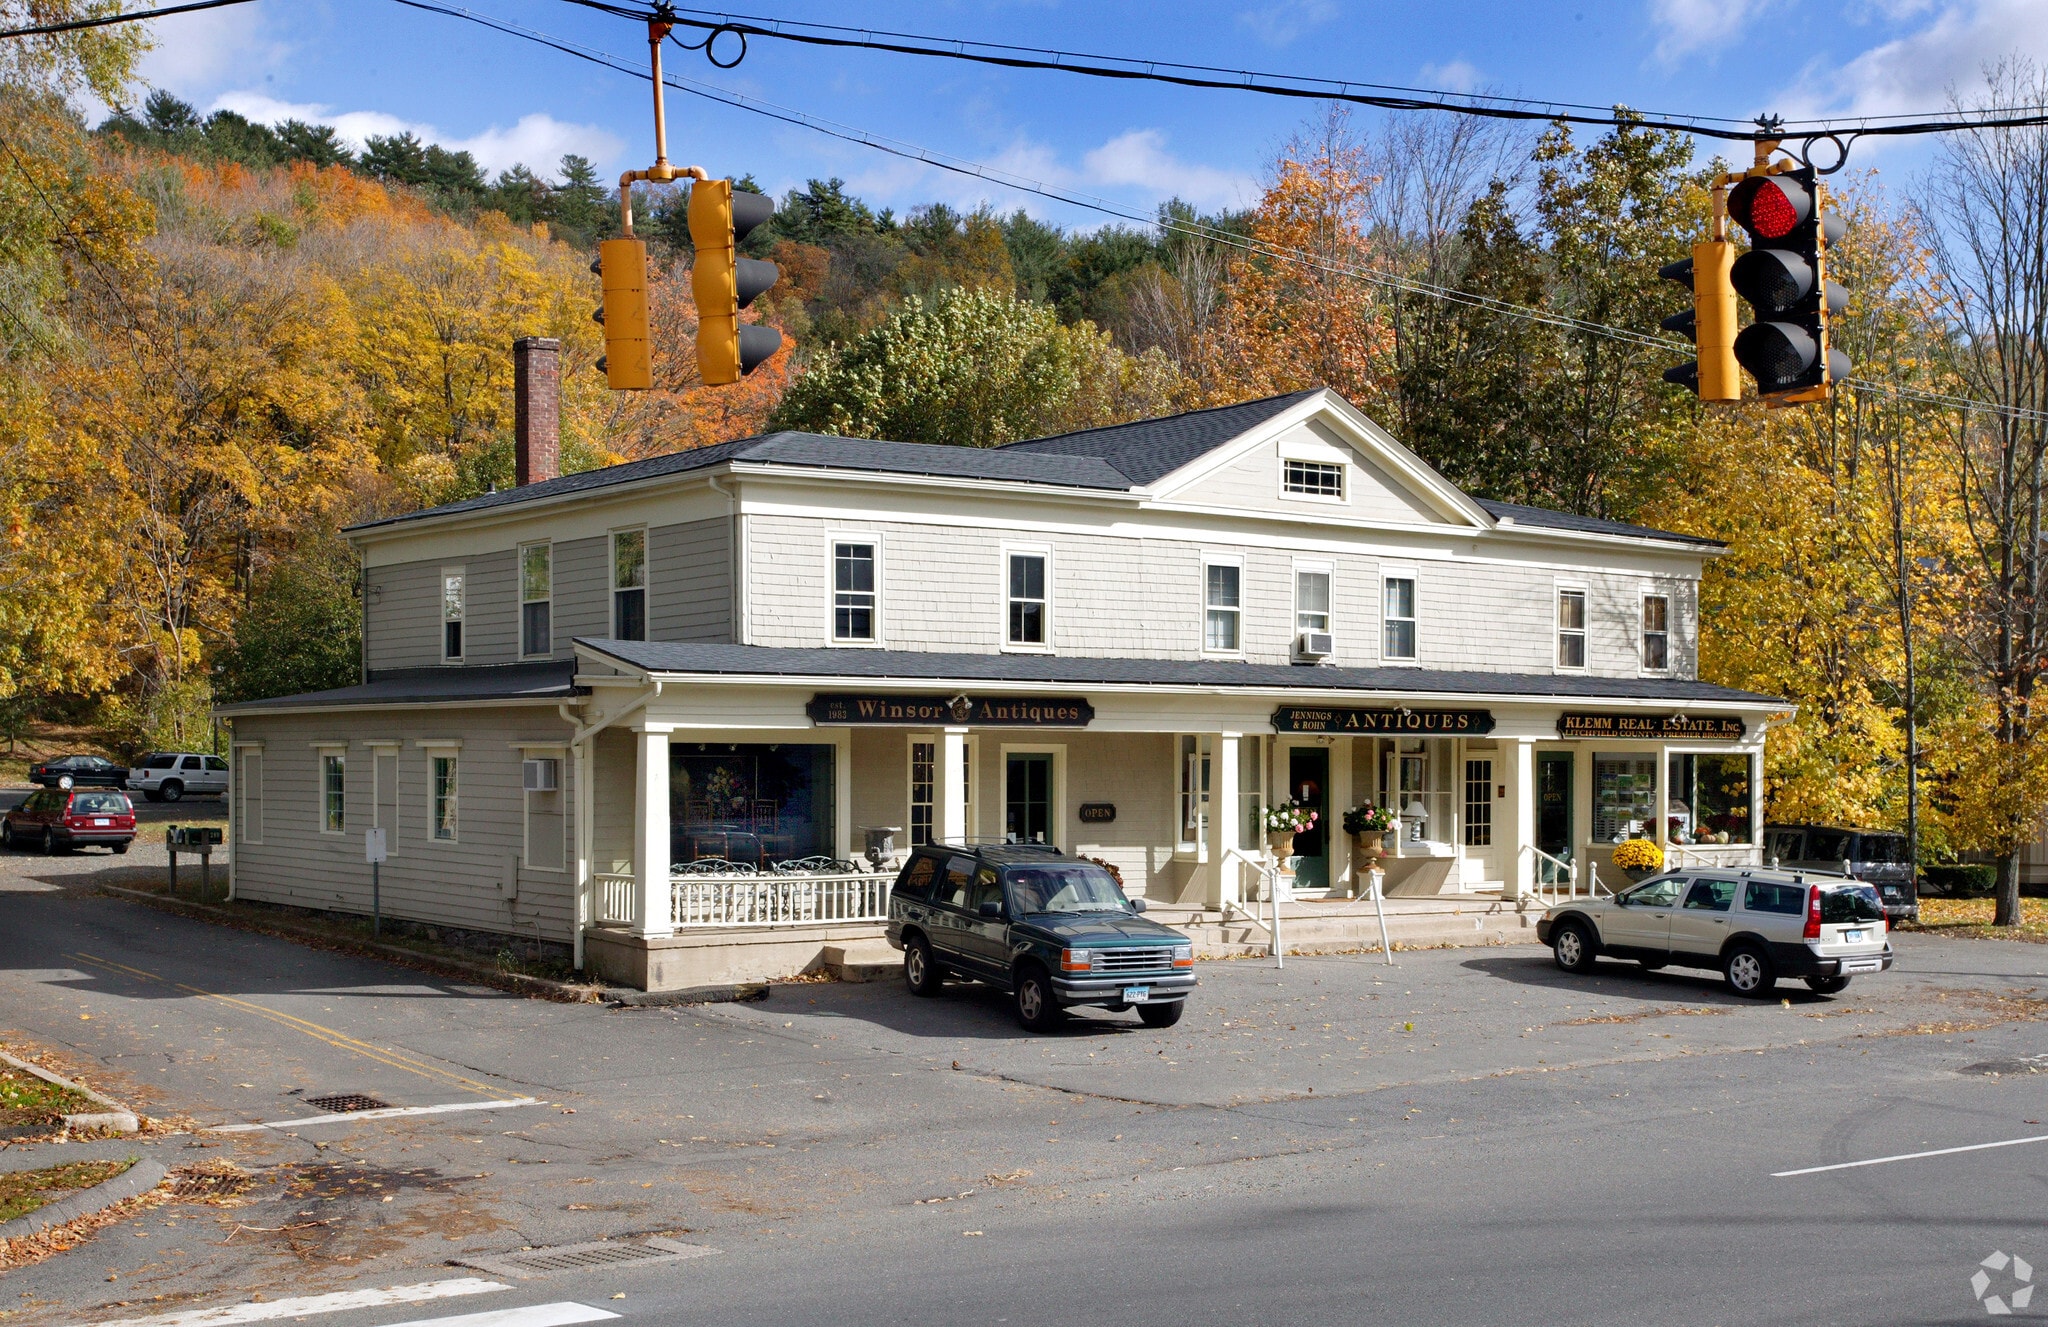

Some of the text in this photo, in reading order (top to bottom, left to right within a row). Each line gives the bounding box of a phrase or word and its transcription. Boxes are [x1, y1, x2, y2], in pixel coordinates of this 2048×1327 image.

[828, 709, 848, 720] 1983
[857, 700, 1079, 723] Winsor Antiques
[1290, 711, 1332, 720] JENNINGS
[1293, 721, 1326, 730] & ROHN
[1345, 713, 1468, 729] ANTIQUES
[1565, 716, 1612, 729] KLEMM
[1618, 718, 1655, 730] REAL
[1565, 729, 1618, 737] LITCHFIELD
[1619, 730, 1662, 738] COUNTY'S
[1663, 731, 1701, 739] PREMIER
[1543, 792, 1562, 802] OPEN
[1085, 808, 1111, 818] OPEN
